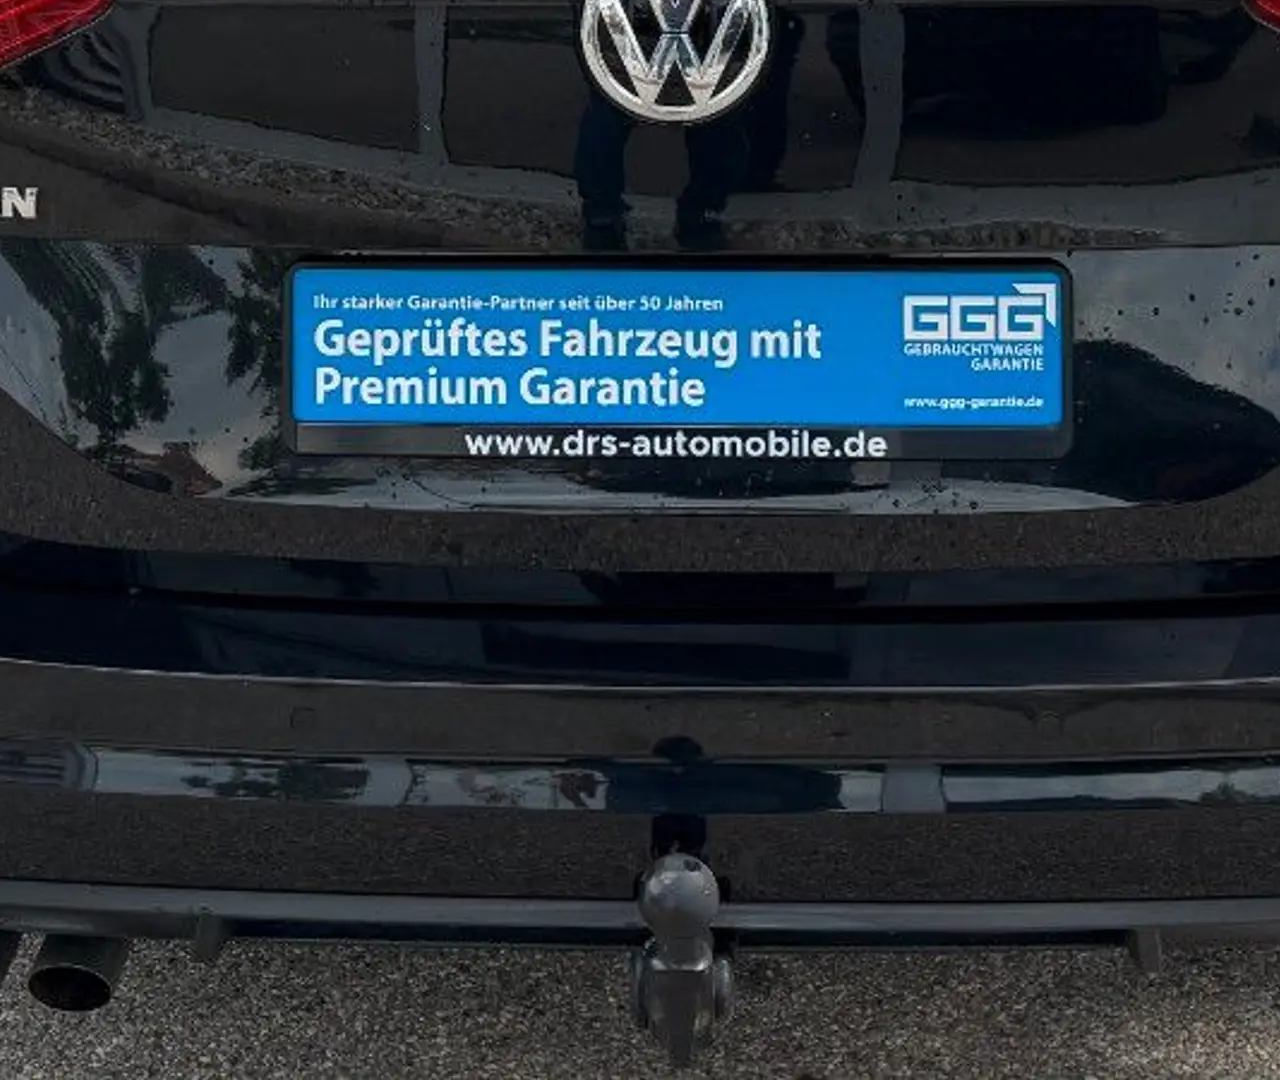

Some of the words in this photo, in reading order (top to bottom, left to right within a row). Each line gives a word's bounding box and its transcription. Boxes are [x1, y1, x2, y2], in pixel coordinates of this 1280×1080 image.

[312, 293, 339, 310] Ihr
[342, 294, 404, 310] starker
[408, 294, 554, 311] Garantie-Partner
[558, 294, 590, 311] seit
[594, 294, 636, 311] über
[640, 296, 660, 311] 50
[665, 295, 723, 311] Jahren
[903, 295, 1045, 340] GGG
[314, 317, 528, 366] Geprüftes
[539, 318, 738, 368] Fahrzeug
[750, 320, 822, 359] mit
[903, 342, 1044, 357] GEBRAUCHTWAGEN
[971, 357, 1045, 371] GARANTIE
[315, 365, 507, 405] Premium
[519, 366, 706, 407] Garantie
[903, 395, 1045, 410] www.ggg-garantie.de
[464, 428, 888, 458] www.drs-automobile.de
